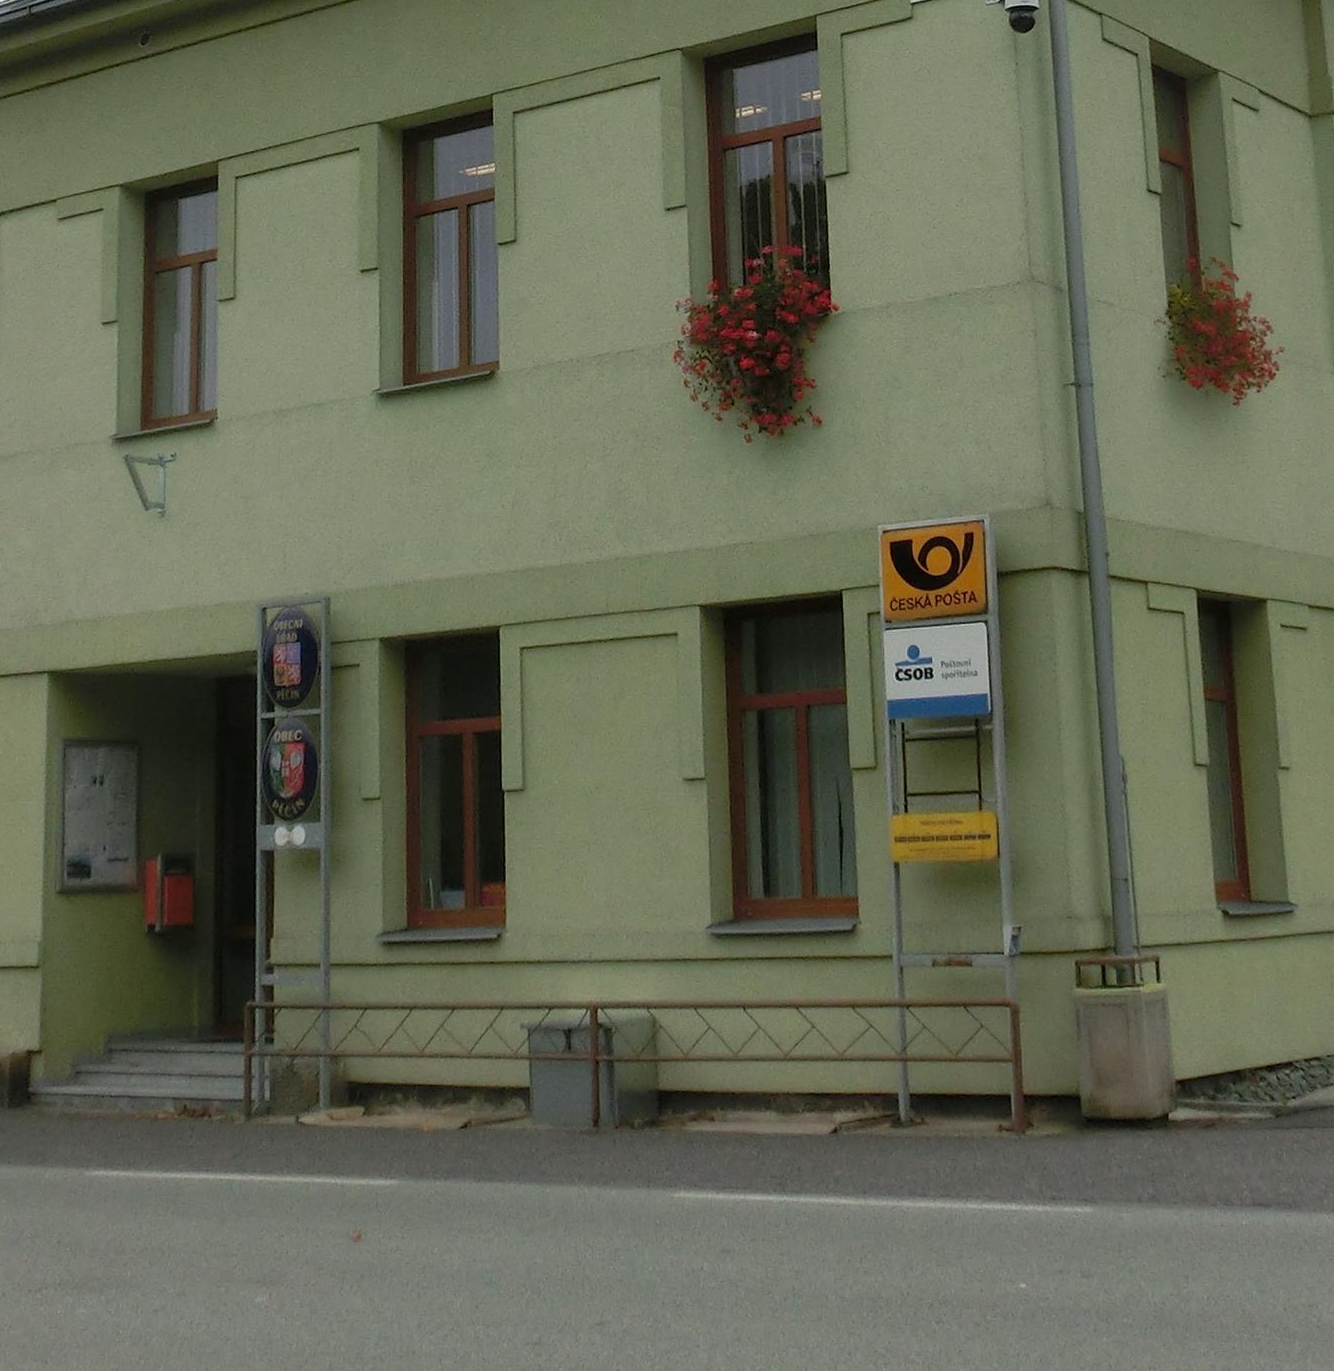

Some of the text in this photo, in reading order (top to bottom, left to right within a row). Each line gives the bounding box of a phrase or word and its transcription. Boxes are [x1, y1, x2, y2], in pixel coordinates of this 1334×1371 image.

[890, 590, 977, 611] ČESKÁ POŠTA
[940, 659, 971, 668] Poštovní
[894, 667, 934, 681] ČSOB
[941, 669, 978, 680] spořitelna
[273, 729, 303, 742] OBEC
